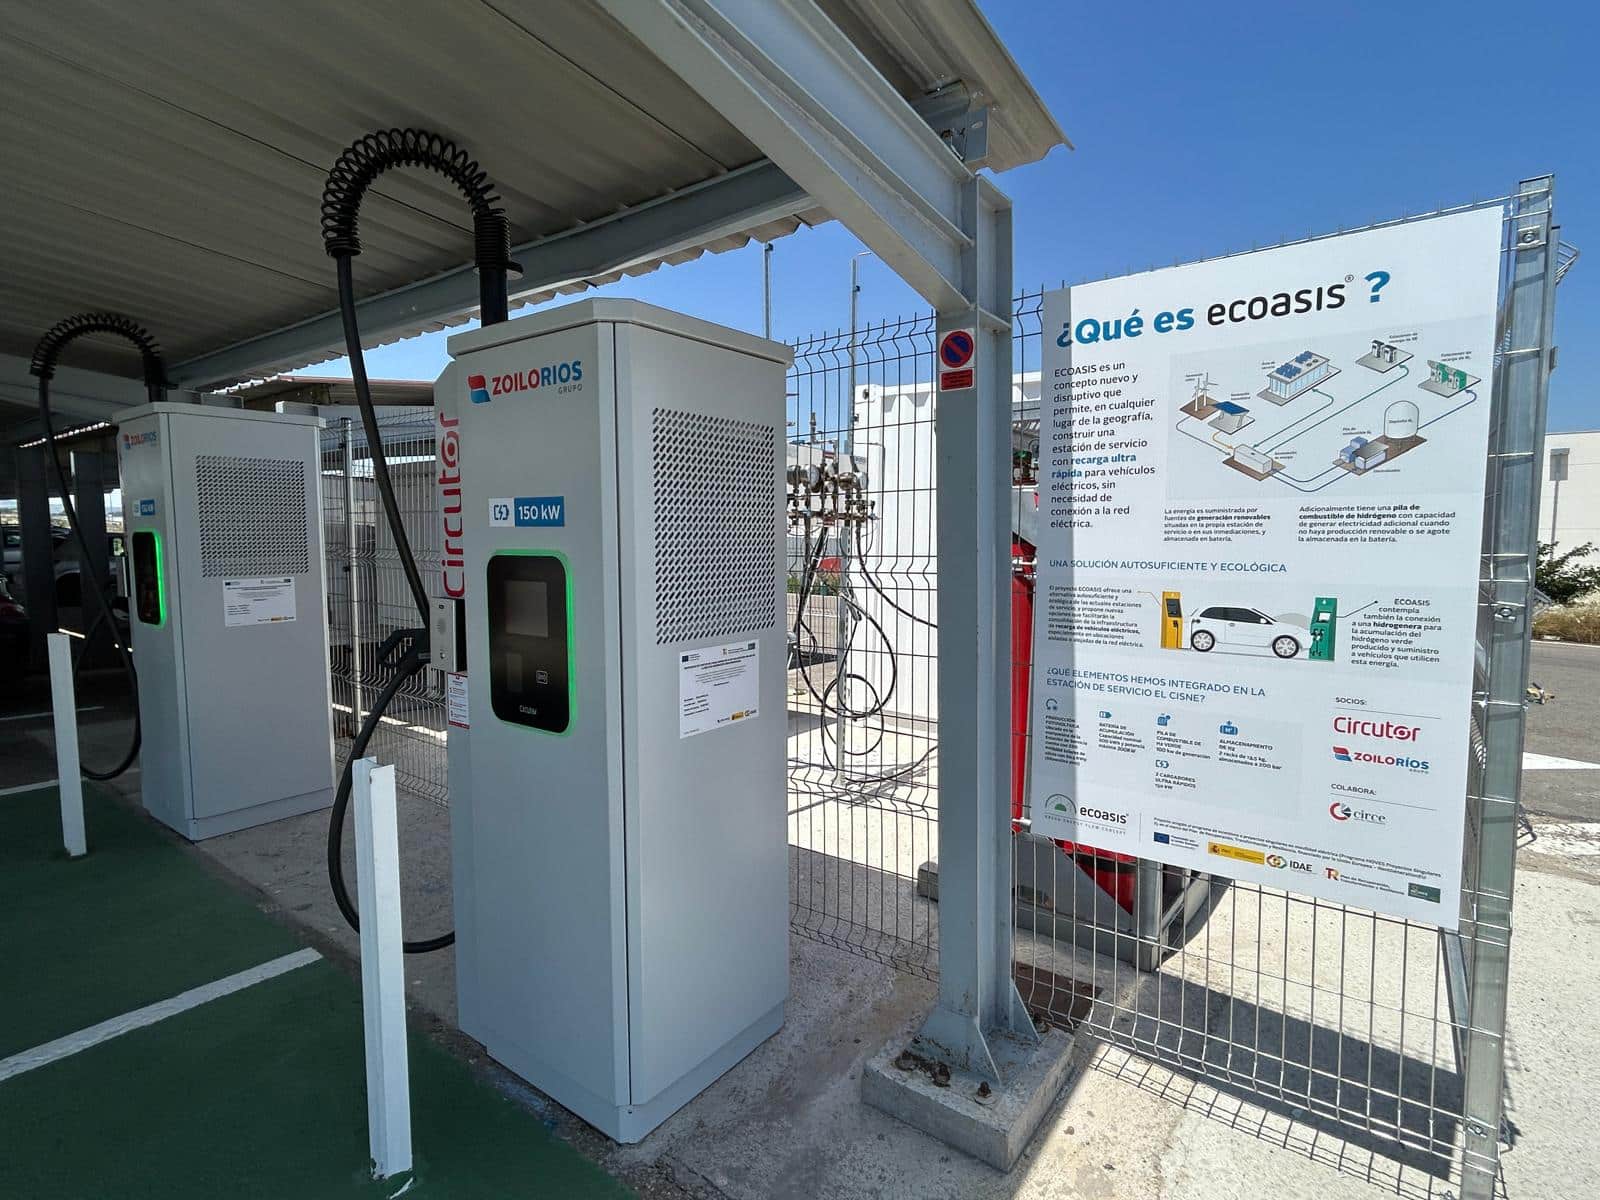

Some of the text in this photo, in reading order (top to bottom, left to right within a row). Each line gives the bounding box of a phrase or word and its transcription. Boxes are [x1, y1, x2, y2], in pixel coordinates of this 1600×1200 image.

[1056, 309, 1144, 347] ¿Qué
[1154, 308, 1195, 333] es
[1054, 365, 1096, 377] ECOASIS
[1099, 363, 1110, 372] es
[1054, 374, 1138, 390] concepto nuevo y
[558, 384, 583, 394] GRUPO
[1054, 389, 1122, 402] disruptivo que
[1109, 398, 1155, 410] cualquier
[1053, 419, 1076, 429] lugar
[1079, 417, 1090, 426] de
[1093, 416, 1100, 424] la
[1053, 429, 1115, 440] construir una
[1052, 439, 1148, 453] estación de servicio
[1071, 456, 1108, 465] recarga
[1111, 454, 1136, 462] ultra
[1052, 466, 1156, 480] rápida para vehículos
[1051, 480, 1116, 491] eléctricos, sin
[438, 412, 464, 597] Circutor
[1051, 494, 1112, 503] necesidad de
[518, 505, 560, 520] 150 kW
[1051, 506, 1092, 516] conexión
[1103, 506, 1110, 515] la
[1113, 506, 1130, 514] red
[1070, 559, 1119, 569] SOLUCIÓN
[1121, 561, 1207, 571] AUTOSUFICIENTE
[1210, 562, 1217, 571] Y
[1220, 560, 1287, 572] ECOLÓGICA
[1373, 621, 1422, 630] hidrogenera
[1072, 669, 1129, 683] ELEMENTOS
[1131, 675, 1166, 687] HEMOS
[1168, 679, 1231, 693] INTEGRADO
[1233, 686, 1249, 695] EN
[1251, 688, 1266, 697] LA
[1047, 678, 1205, 703] ESTACIÓN DE SERVICIO EL CISNE?
[1336, 697, 1367, 705] SOCIOS:
[1334, 717, 1421, 742] Circutor
[1354, 752, 1430, 770] ZOILORÍOS
[1331, 783, 1376, 795] COLABORA:
[1353, 810, 1386, 822] circe
[1289, 860, 1312, 872] IDAE
